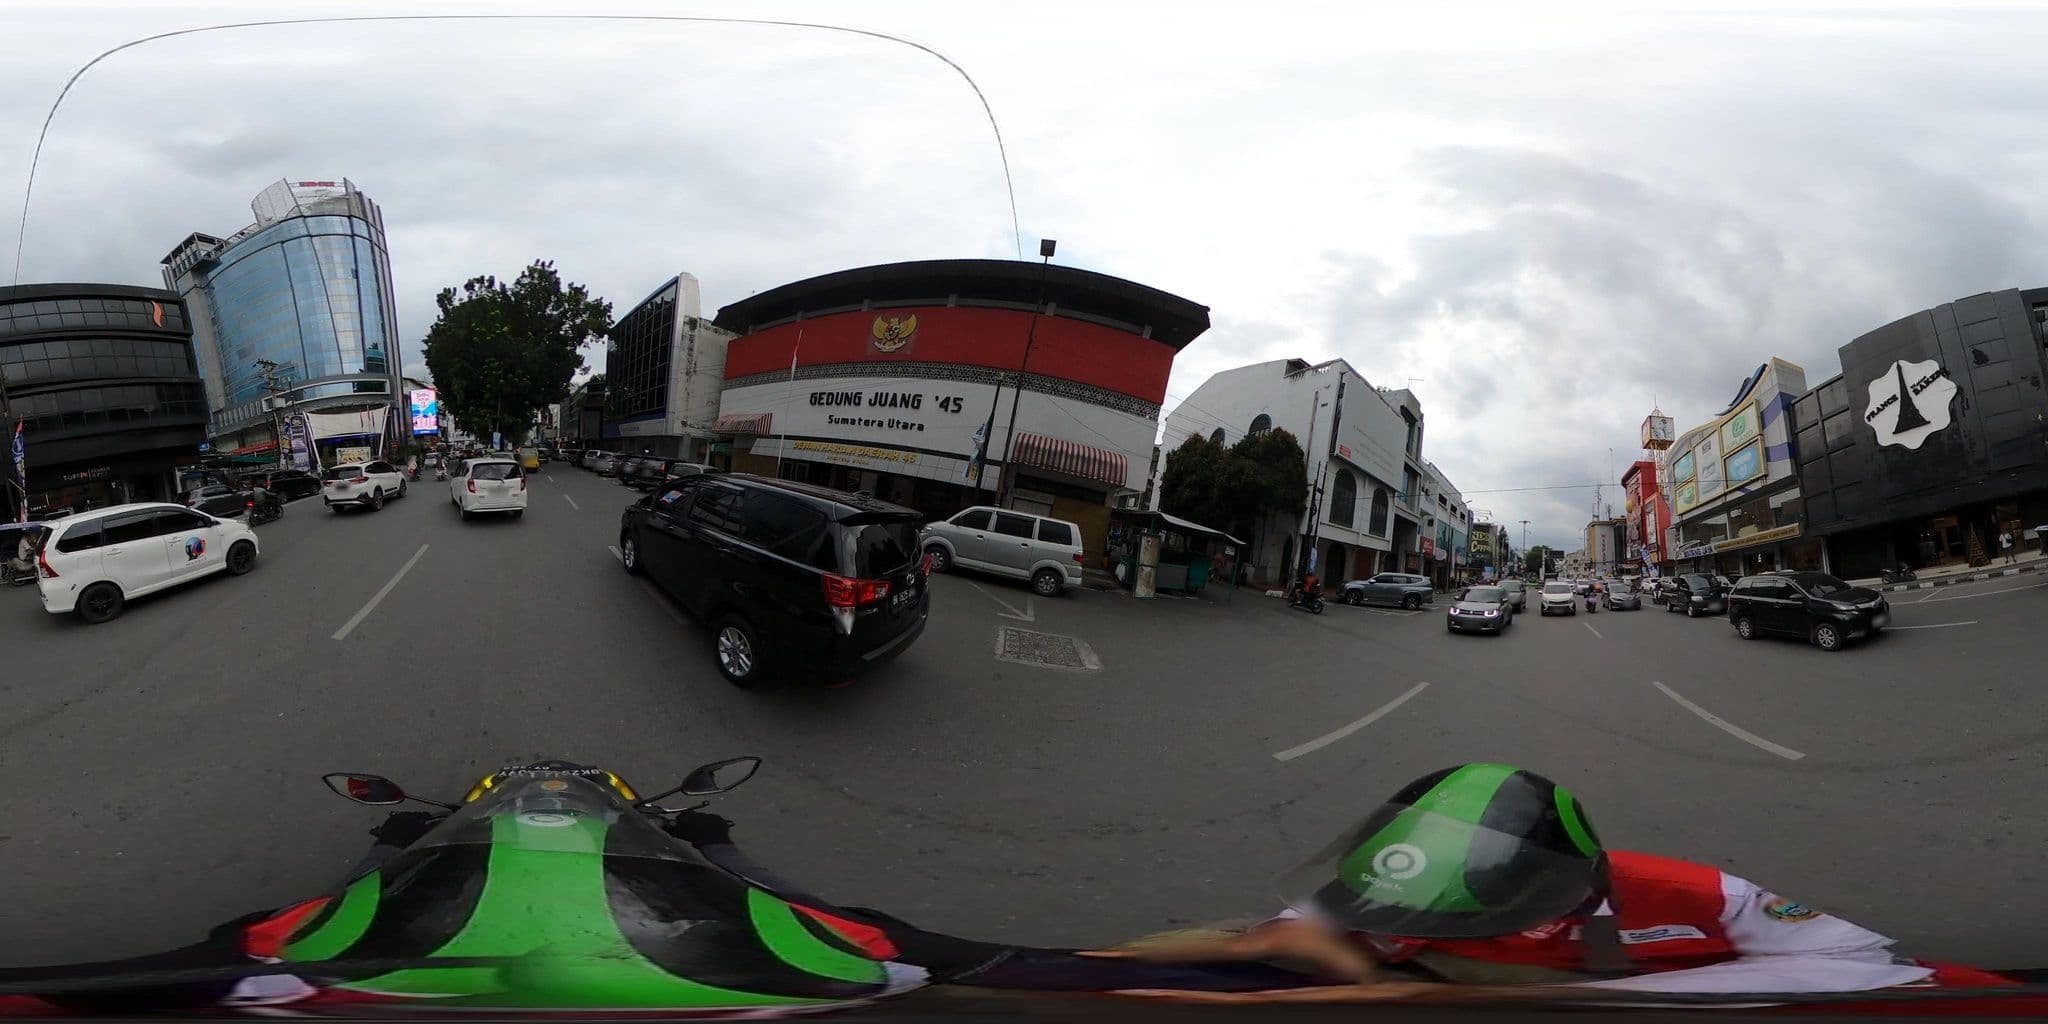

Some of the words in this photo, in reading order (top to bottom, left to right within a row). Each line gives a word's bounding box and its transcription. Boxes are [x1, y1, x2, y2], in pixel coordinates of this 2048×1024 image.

[809, 391, 863, 407] GEDUNG
[868, 392, 922, 410] JUANG
[935, 395, 964, 414] '45
[1866, 394, 1899, 422] FRANCE
[827, 414, 884, 428] Sumatera
[887, 418, 925, 432] Utara
